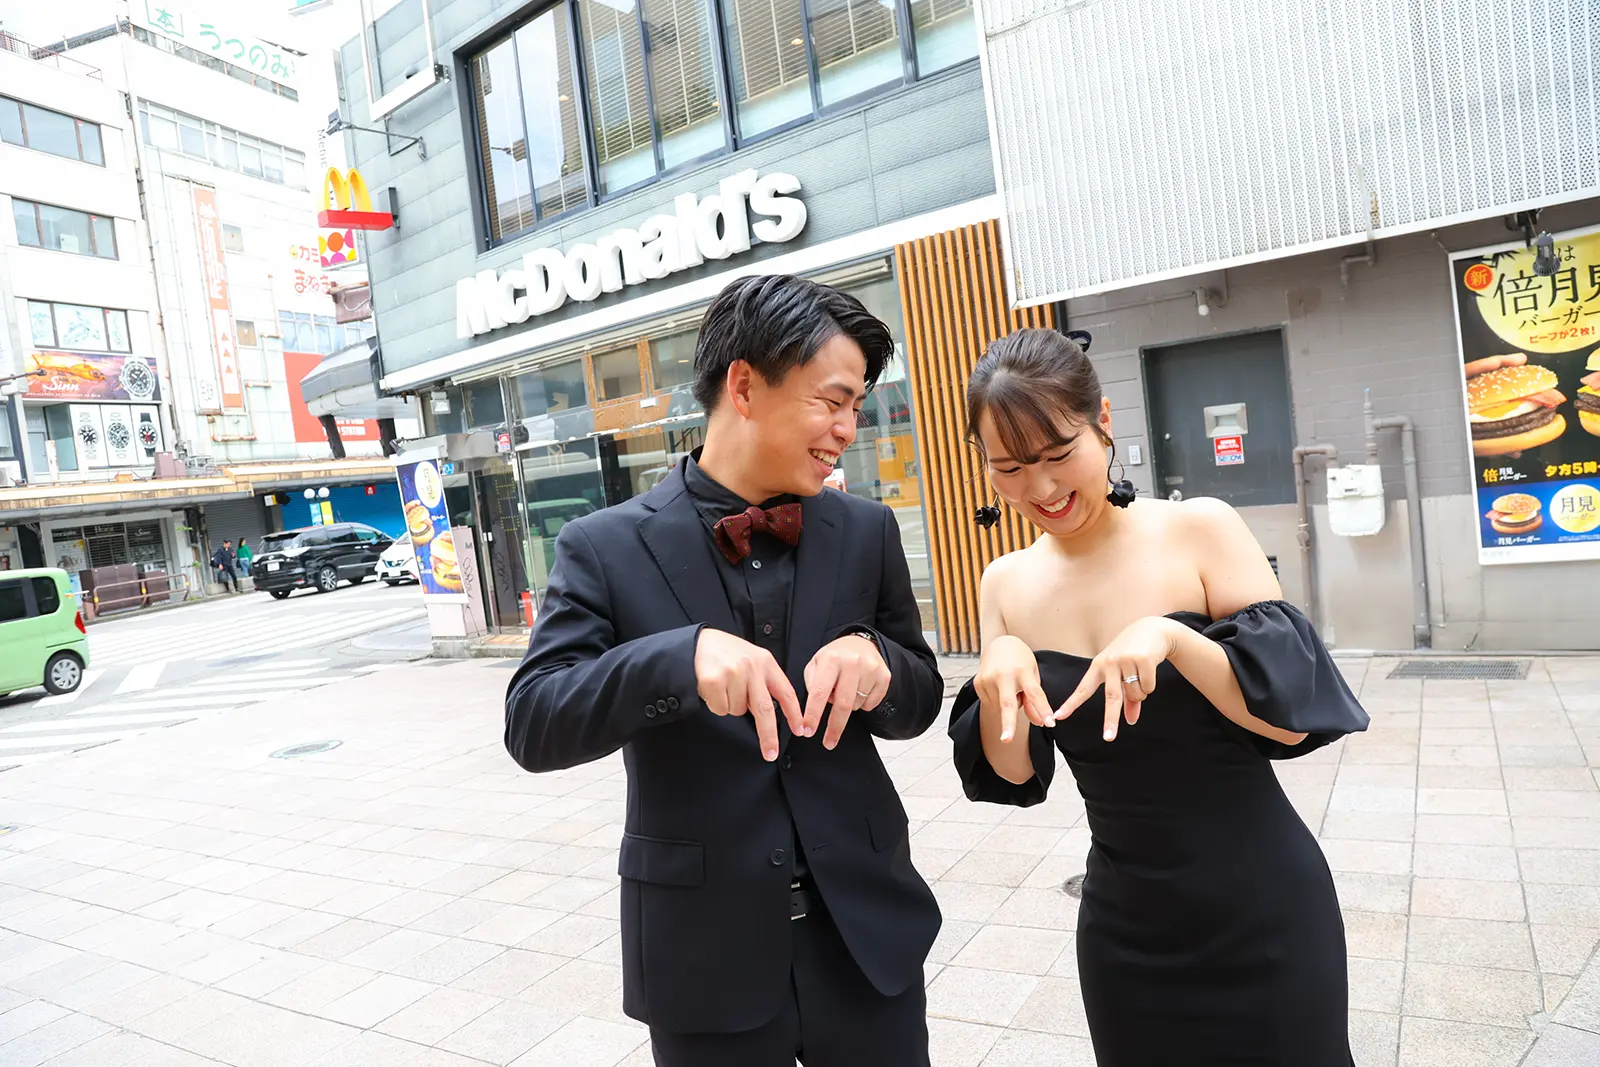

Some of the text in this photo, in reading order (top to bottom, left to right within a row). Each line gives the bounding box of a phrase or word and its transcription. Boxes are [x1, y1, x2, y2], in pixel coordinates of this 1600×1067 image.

[455, 168, 808, 339] McDonald's
[1470, 269, 1488, 286] 新
[1518, 305, 1600, 330] バーガー
[1545, 461, 1600, 477] 夕方5時
[1561, 496, 1596, 513] 月見
